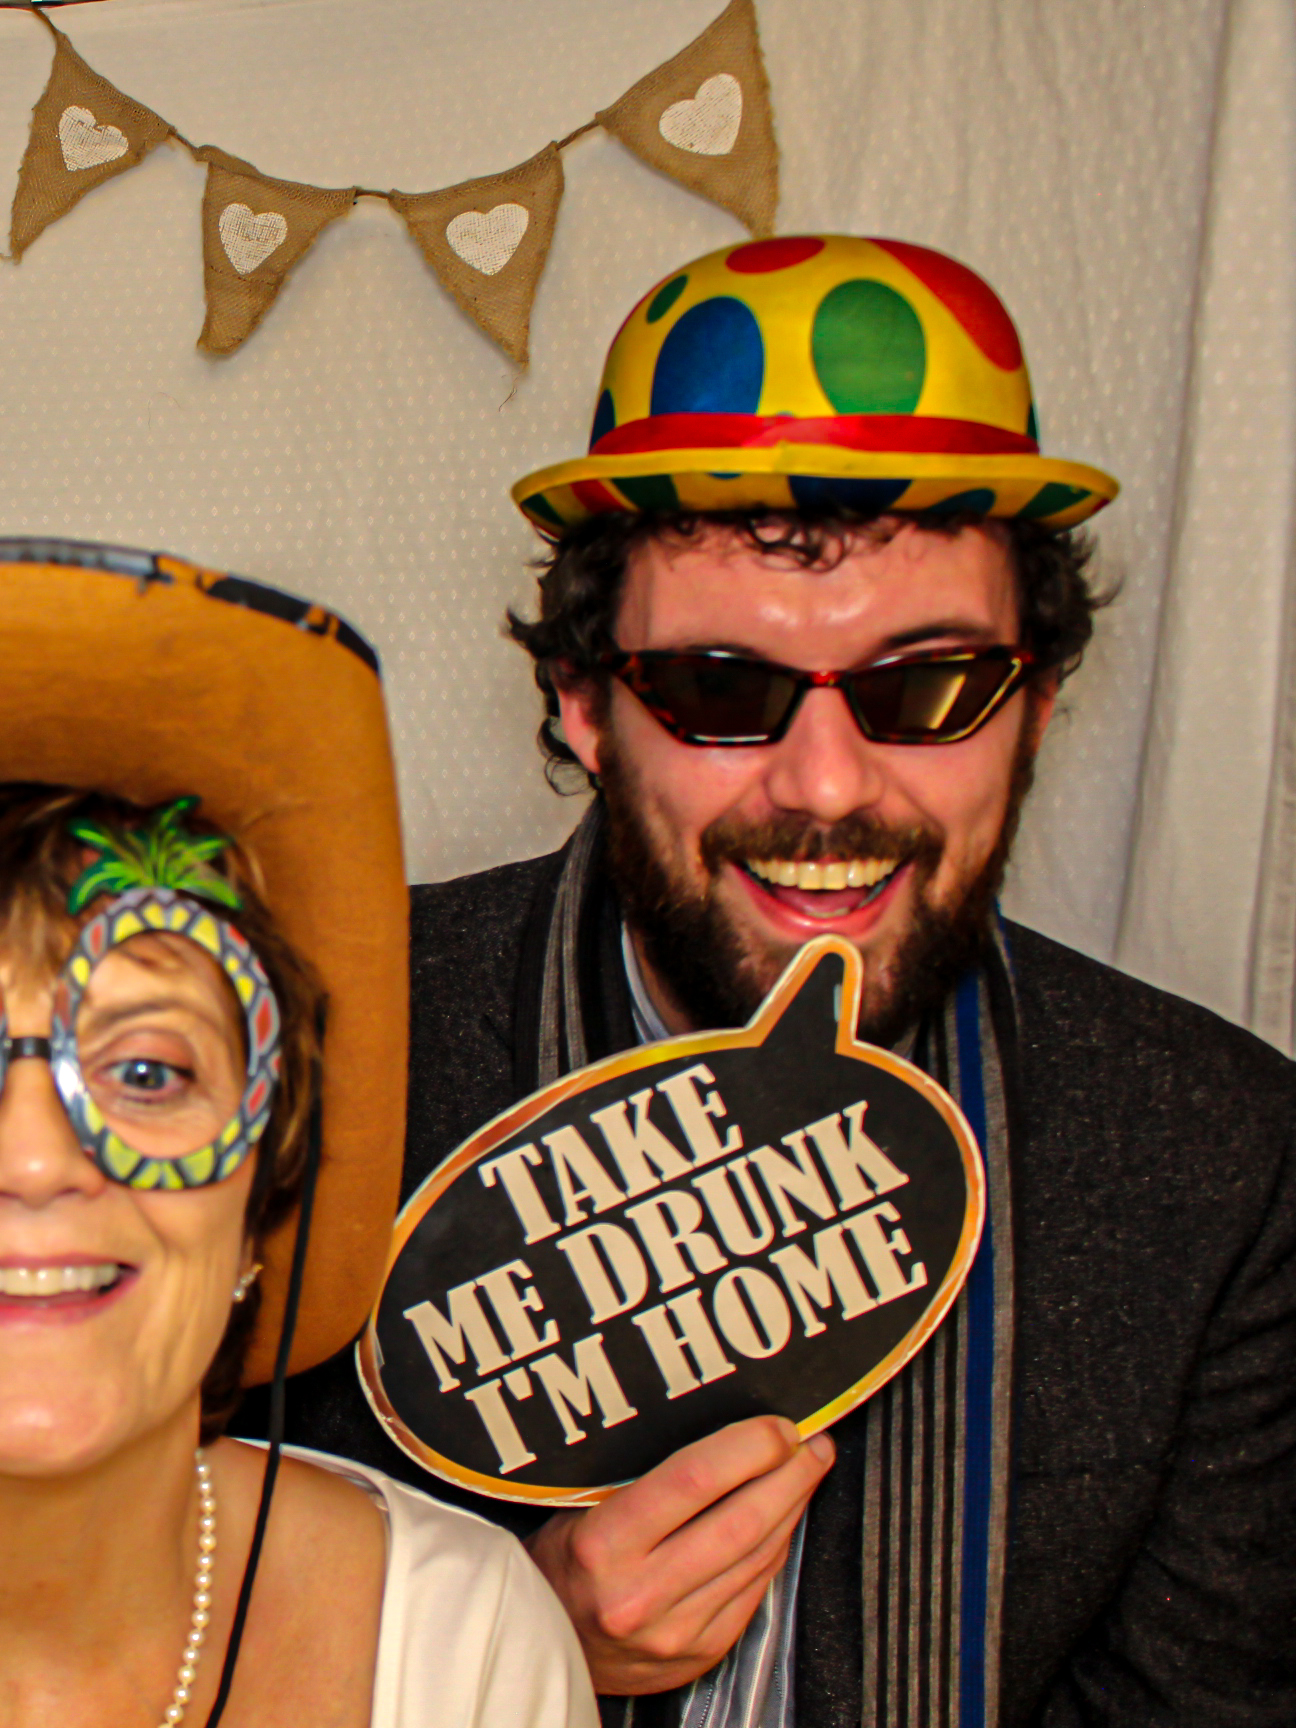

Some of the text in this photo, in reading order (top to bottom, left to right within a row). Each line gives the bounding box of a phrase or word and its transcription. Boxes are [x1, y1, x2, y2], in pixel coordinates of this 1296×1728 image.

[403, 1100, 910, 1392] ME DRUNK
[477, 1063, 744, 1245] TAKE
[464, 1201, 928, 1475] I'M HOME
